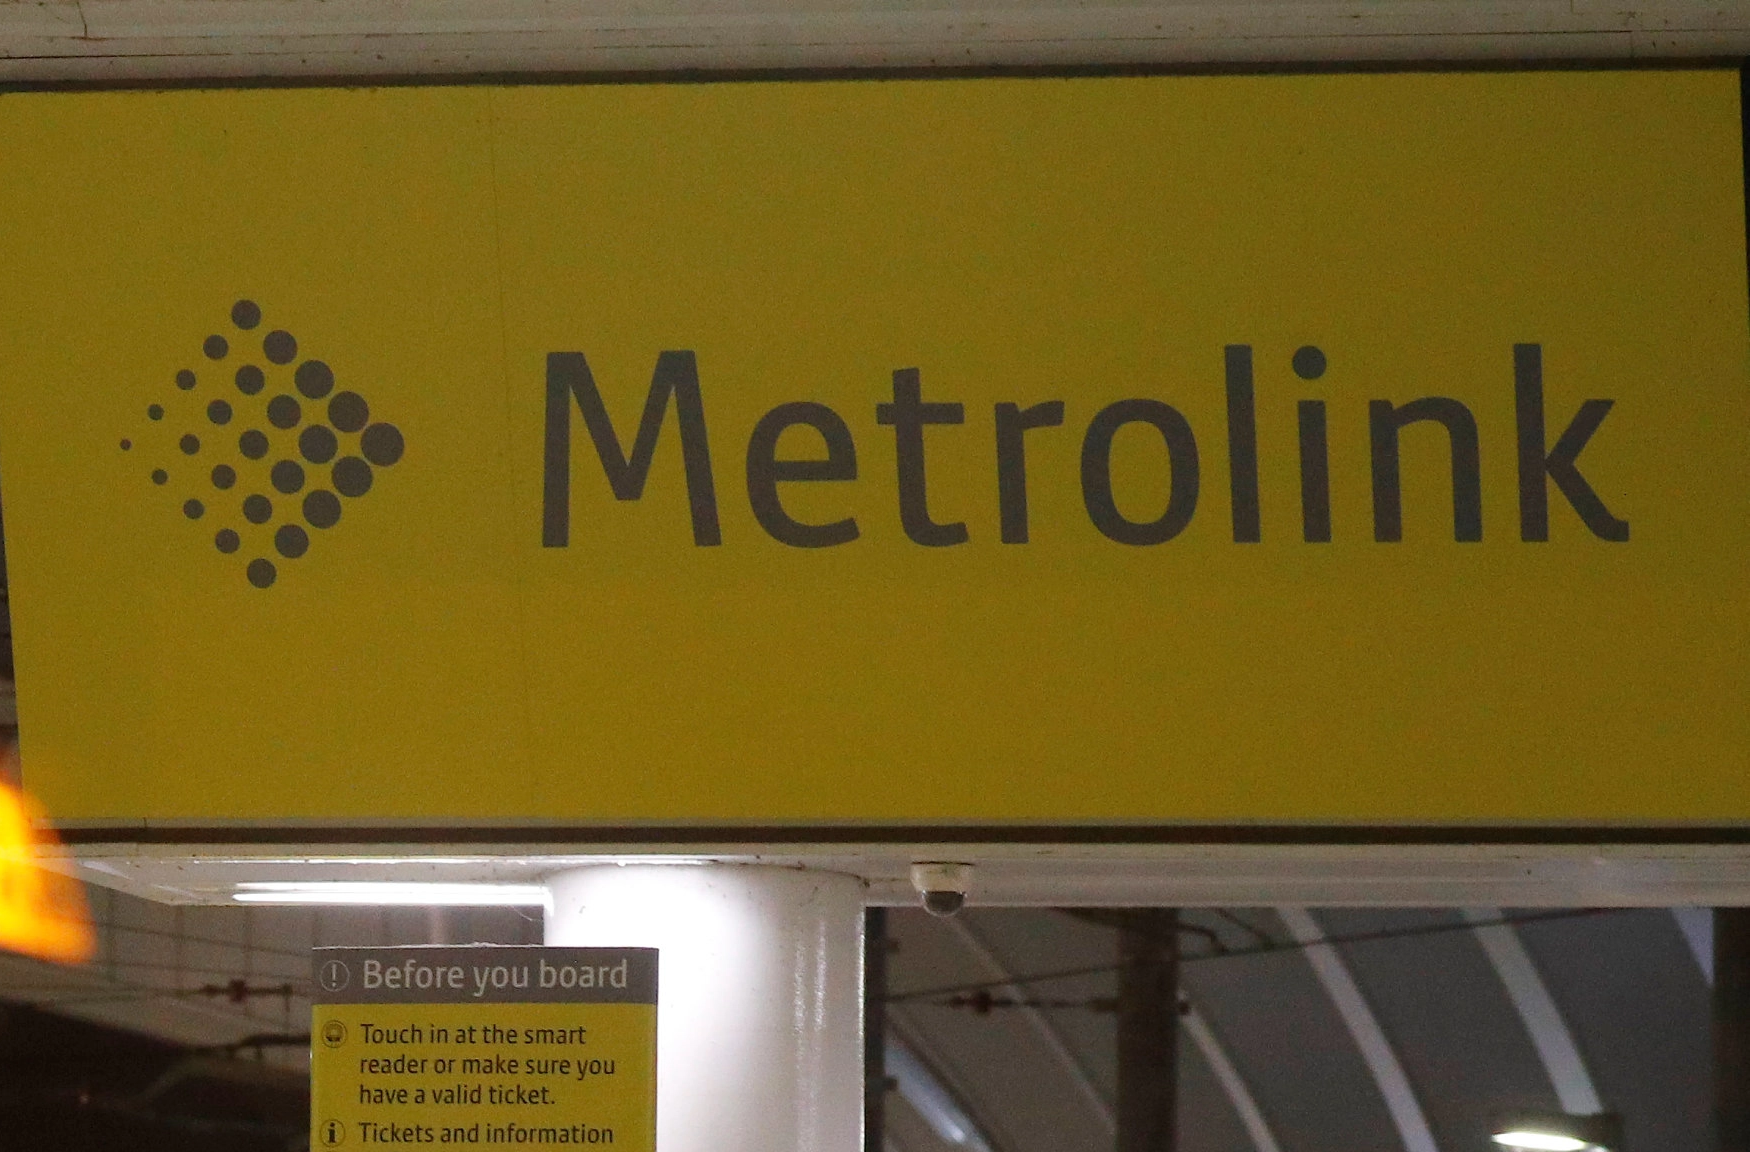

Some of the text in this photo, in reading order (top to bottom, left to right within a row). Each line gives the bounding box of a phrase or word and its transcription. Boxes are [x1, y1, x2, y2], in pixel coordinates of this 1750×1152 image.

[541, 342, 1630, 549] Metrolink
[362, 958, 628, 997] Before you board
[360, 1023, 586, 1044] Touch in at the smart
[360, 1054, 616, 1080] reader or make sure you
[359, 1084, 556, 1105] have a valid ticket.
[358, 1122, 614, 1144] Tickets and information
